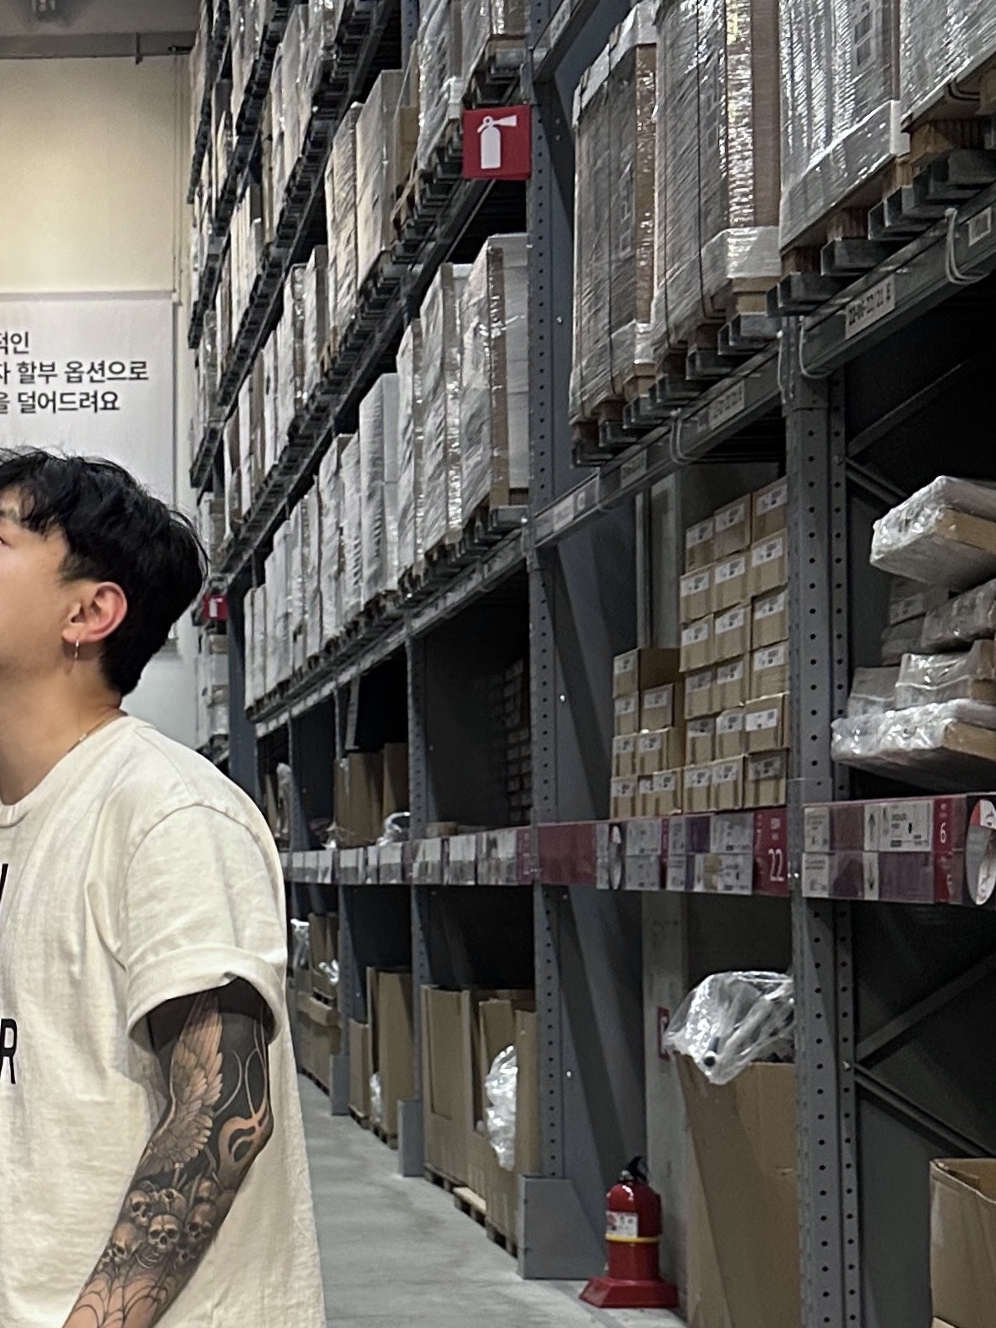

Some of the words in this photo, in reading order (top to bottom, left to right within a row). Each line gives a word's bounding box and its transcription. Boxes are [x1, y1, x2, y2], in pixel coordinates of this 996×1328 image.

[16, 361, 58, 385] 할부
[64, 360, 150, 384] 옵션으로
[17, 390, 121, 415] 덜어드려요
[940, 822, 947, 844] 6
[768, 848, 784, 882] 22
